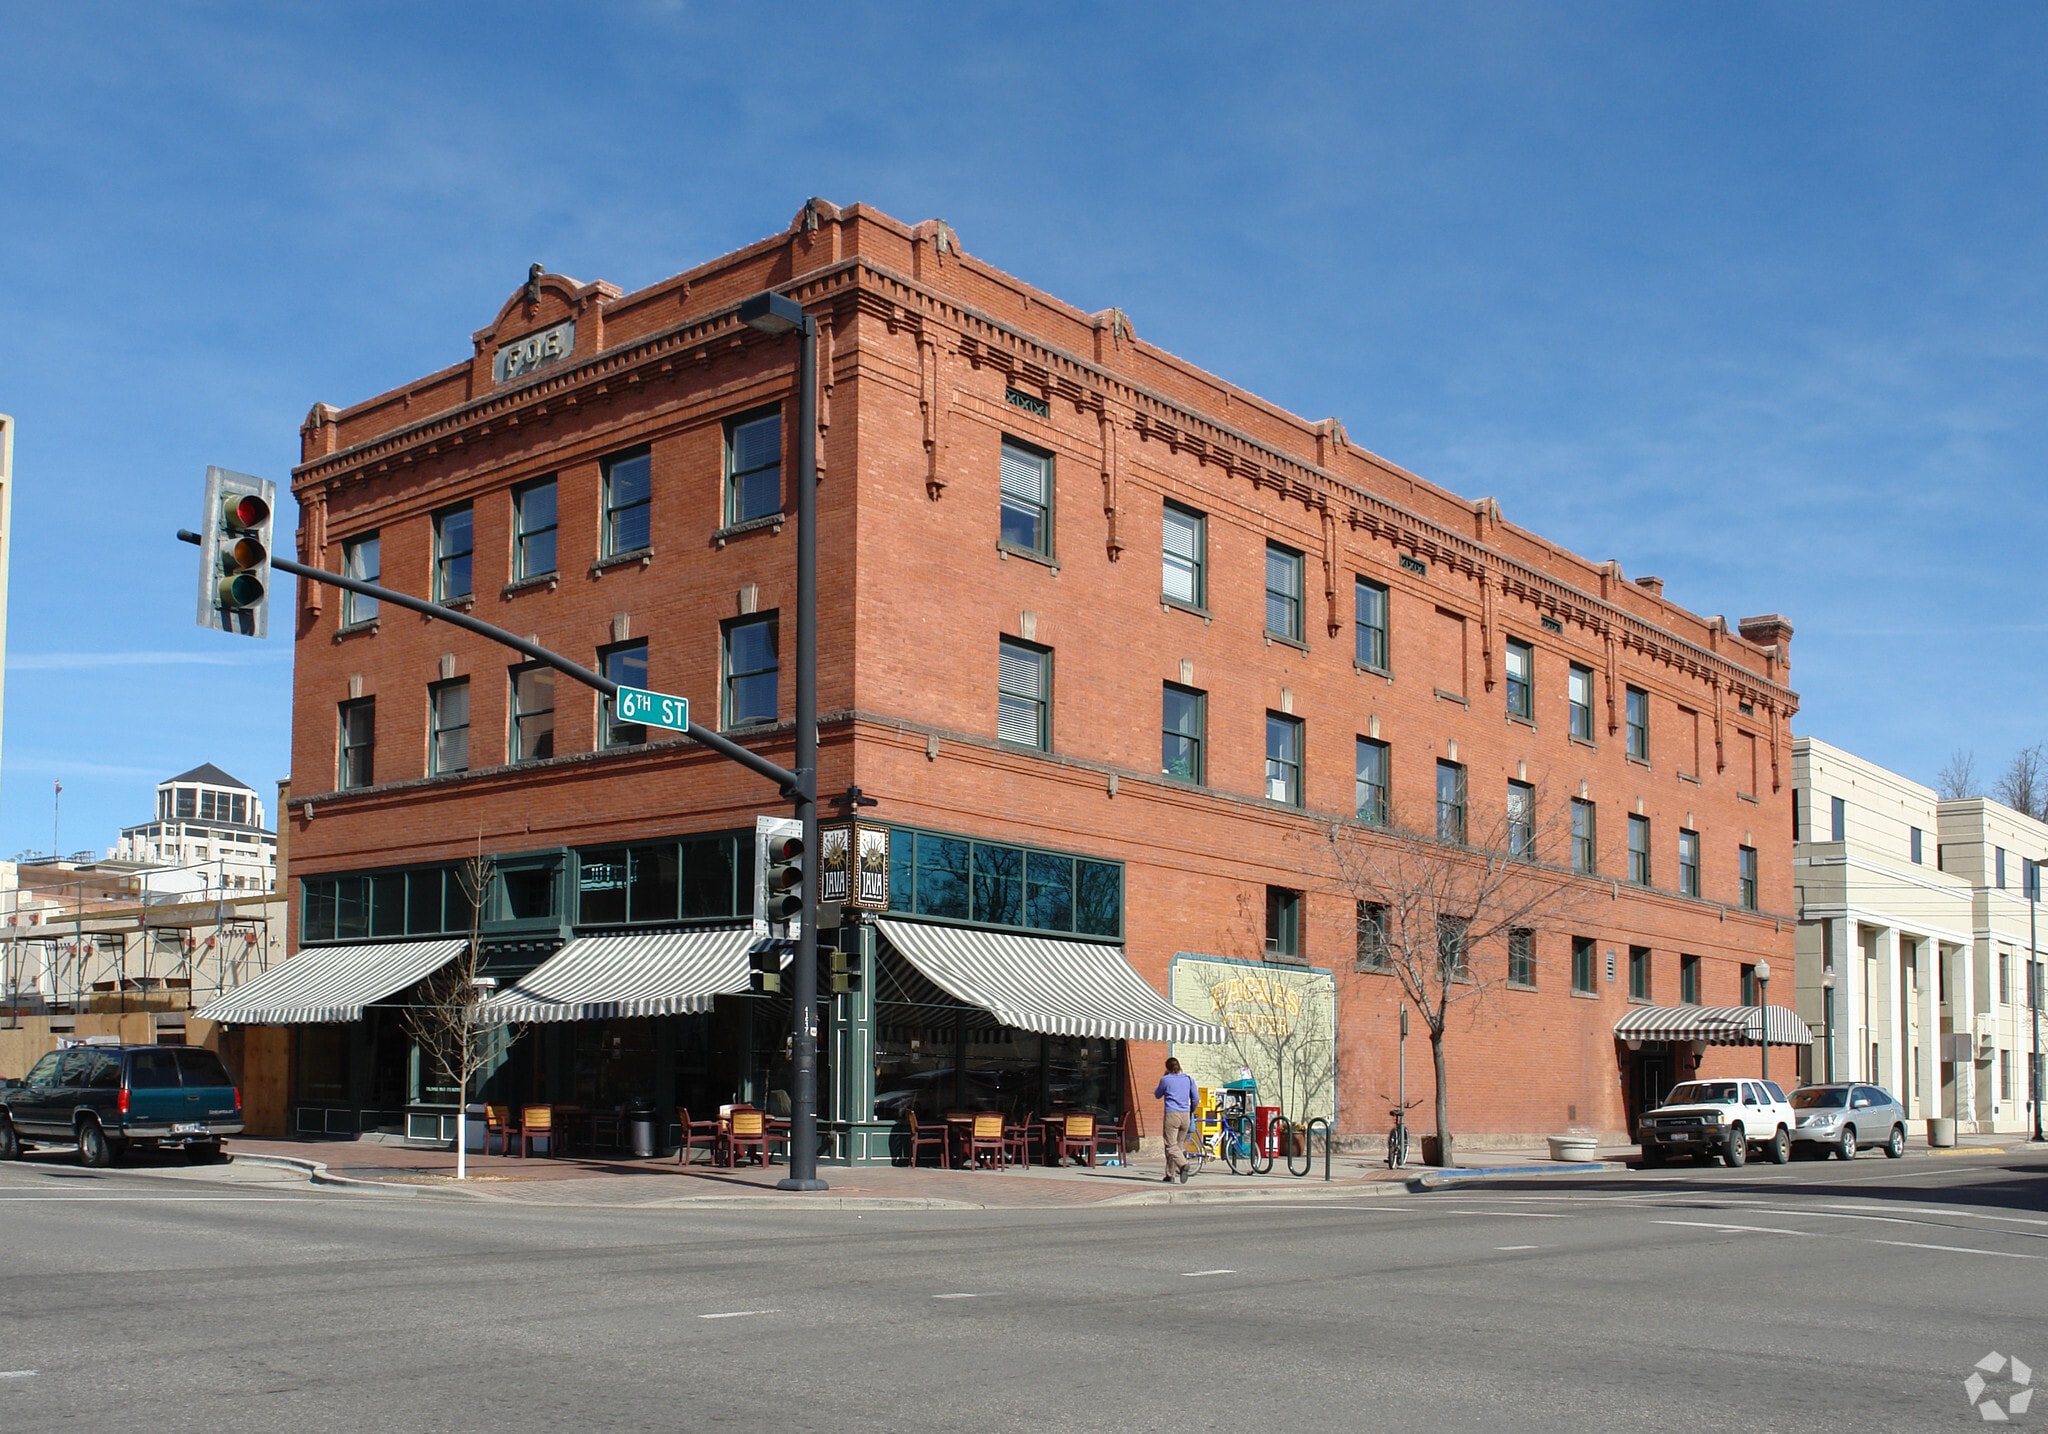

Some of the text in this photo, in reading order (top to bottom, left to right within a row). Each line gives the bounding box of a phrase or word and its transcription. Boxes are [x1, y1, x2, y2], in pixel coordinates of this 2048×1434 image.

[623, 692, 685, 726] 6TH ST
[825, 871, 845, 898] JAVA
[862, 872, 883, 898] JAVA
[1211, 976, 1299, 1017] EAGLES
[1223, 1012, 1288, 1037] CENTER
